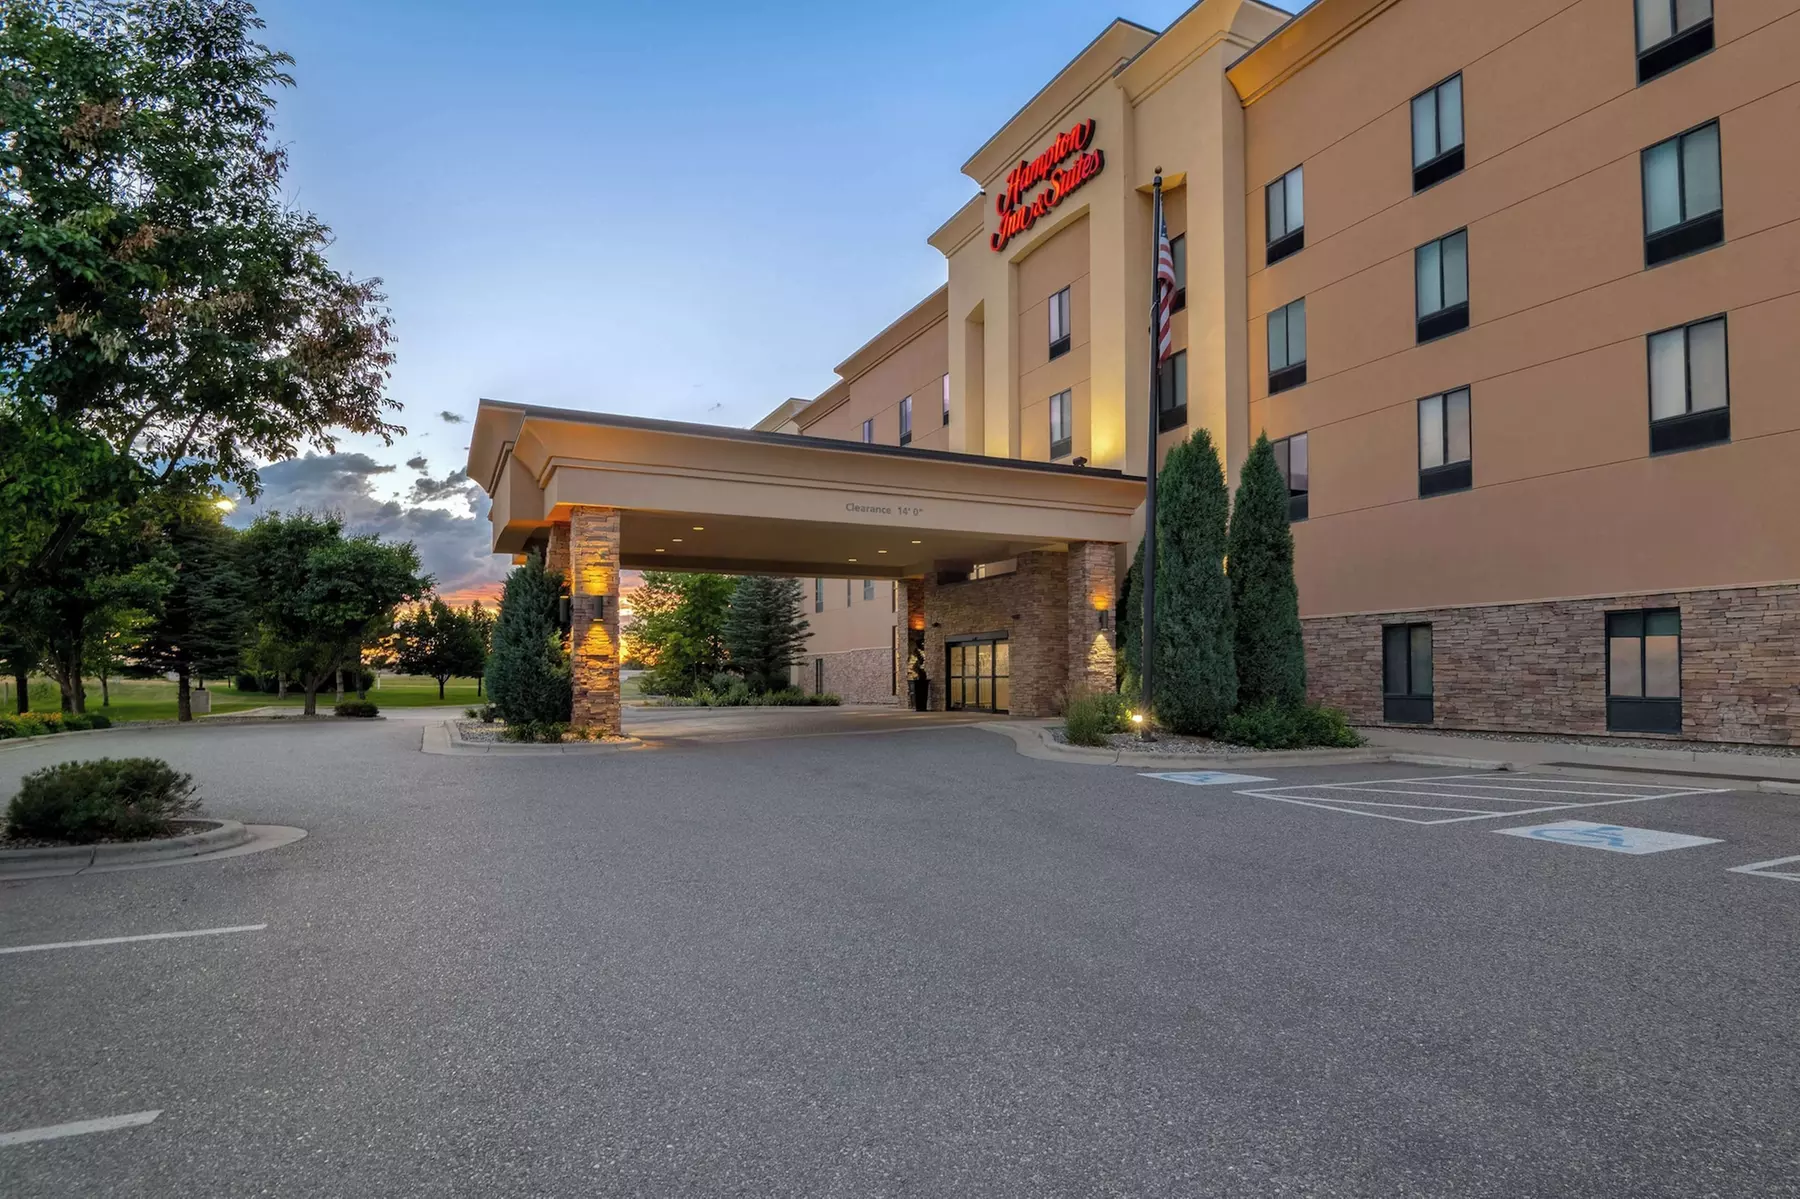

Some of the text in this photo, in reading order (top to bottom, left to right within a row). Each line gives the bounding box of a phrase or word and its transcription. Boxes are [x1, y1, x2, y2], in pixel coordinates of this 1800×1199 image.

[990, 205, 1035, 252] Inn
[1044, 148, 1105, 207] Suites
[996, 118, 1096, 216] Hampton
[845, 503, 892, 514] Clearance
